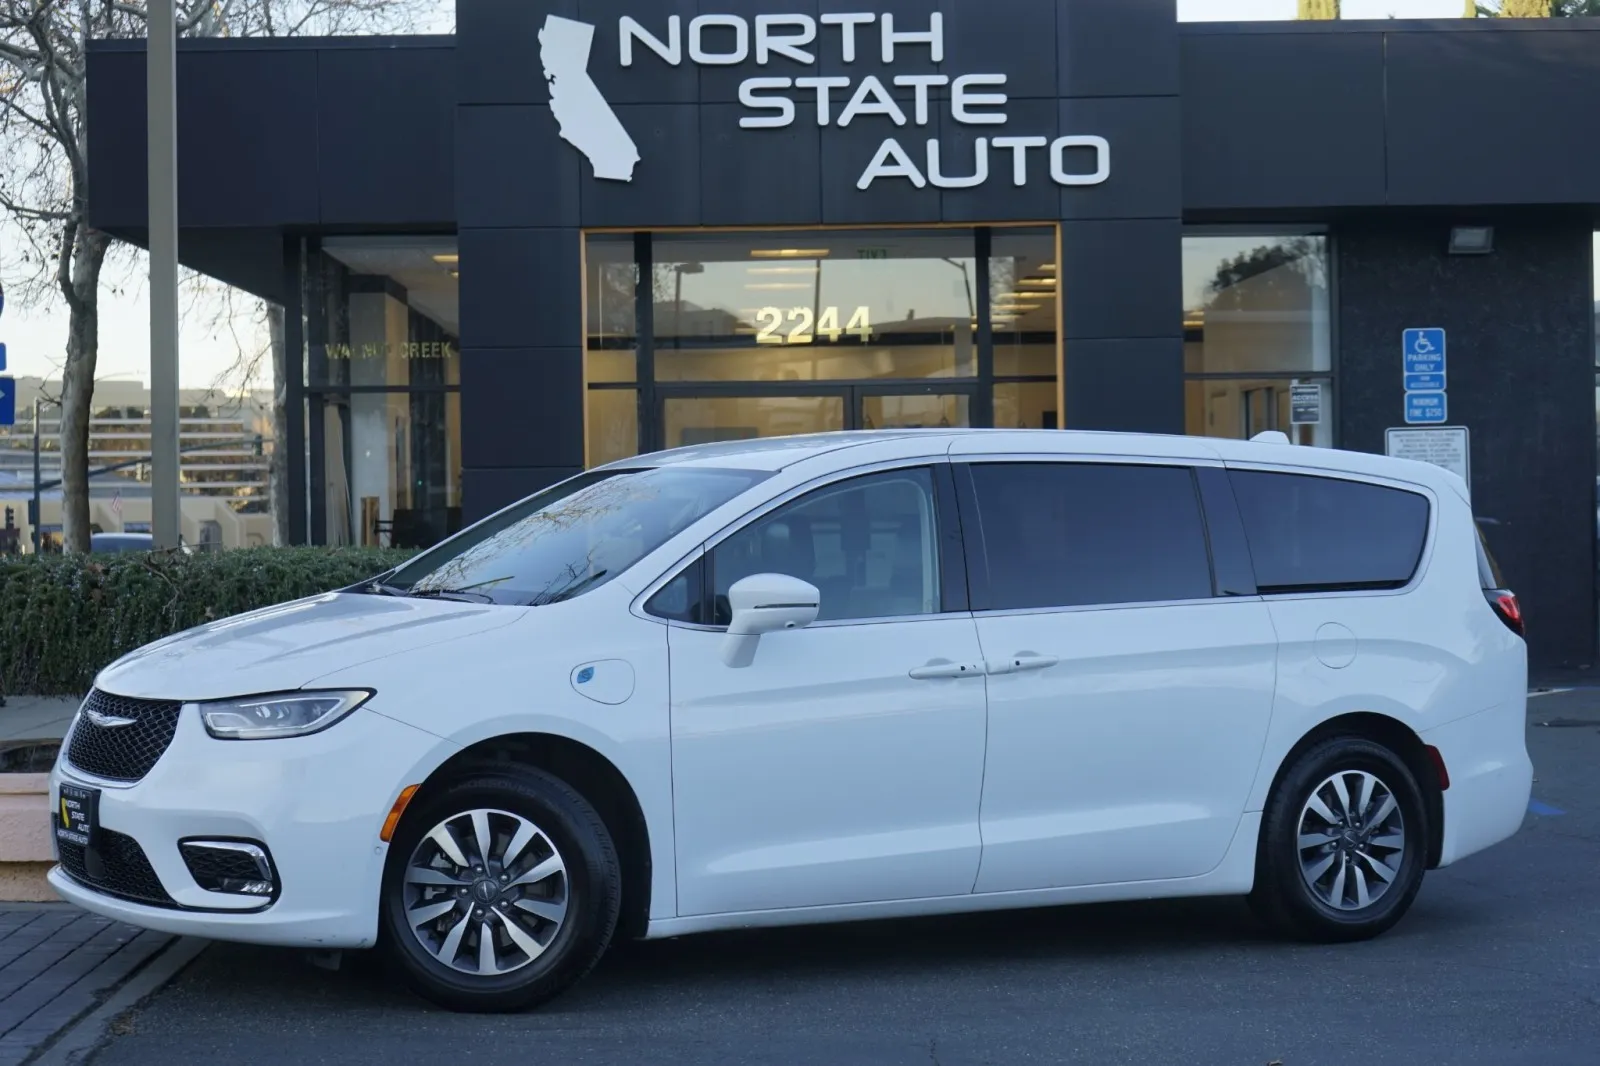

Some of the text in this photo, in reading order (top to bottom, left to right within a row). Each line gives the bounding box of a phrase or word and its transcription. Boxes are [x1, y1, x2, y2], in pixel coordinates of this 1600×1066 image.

[619, 12, 944, 67] NORTH
[738, 73, 1008, 129] STATE
[857, 134, 1111, 190] AUTO
[755, 305, 873, 345] 2244
[399, 341, 451, 359] CREEK
[1407, 353, 1442, 362] PARKING
[1414, 363, 1436, 372] ONLY
[66, 800, 80, 810] NORTH
[71, 811, 85, 822] STATE
